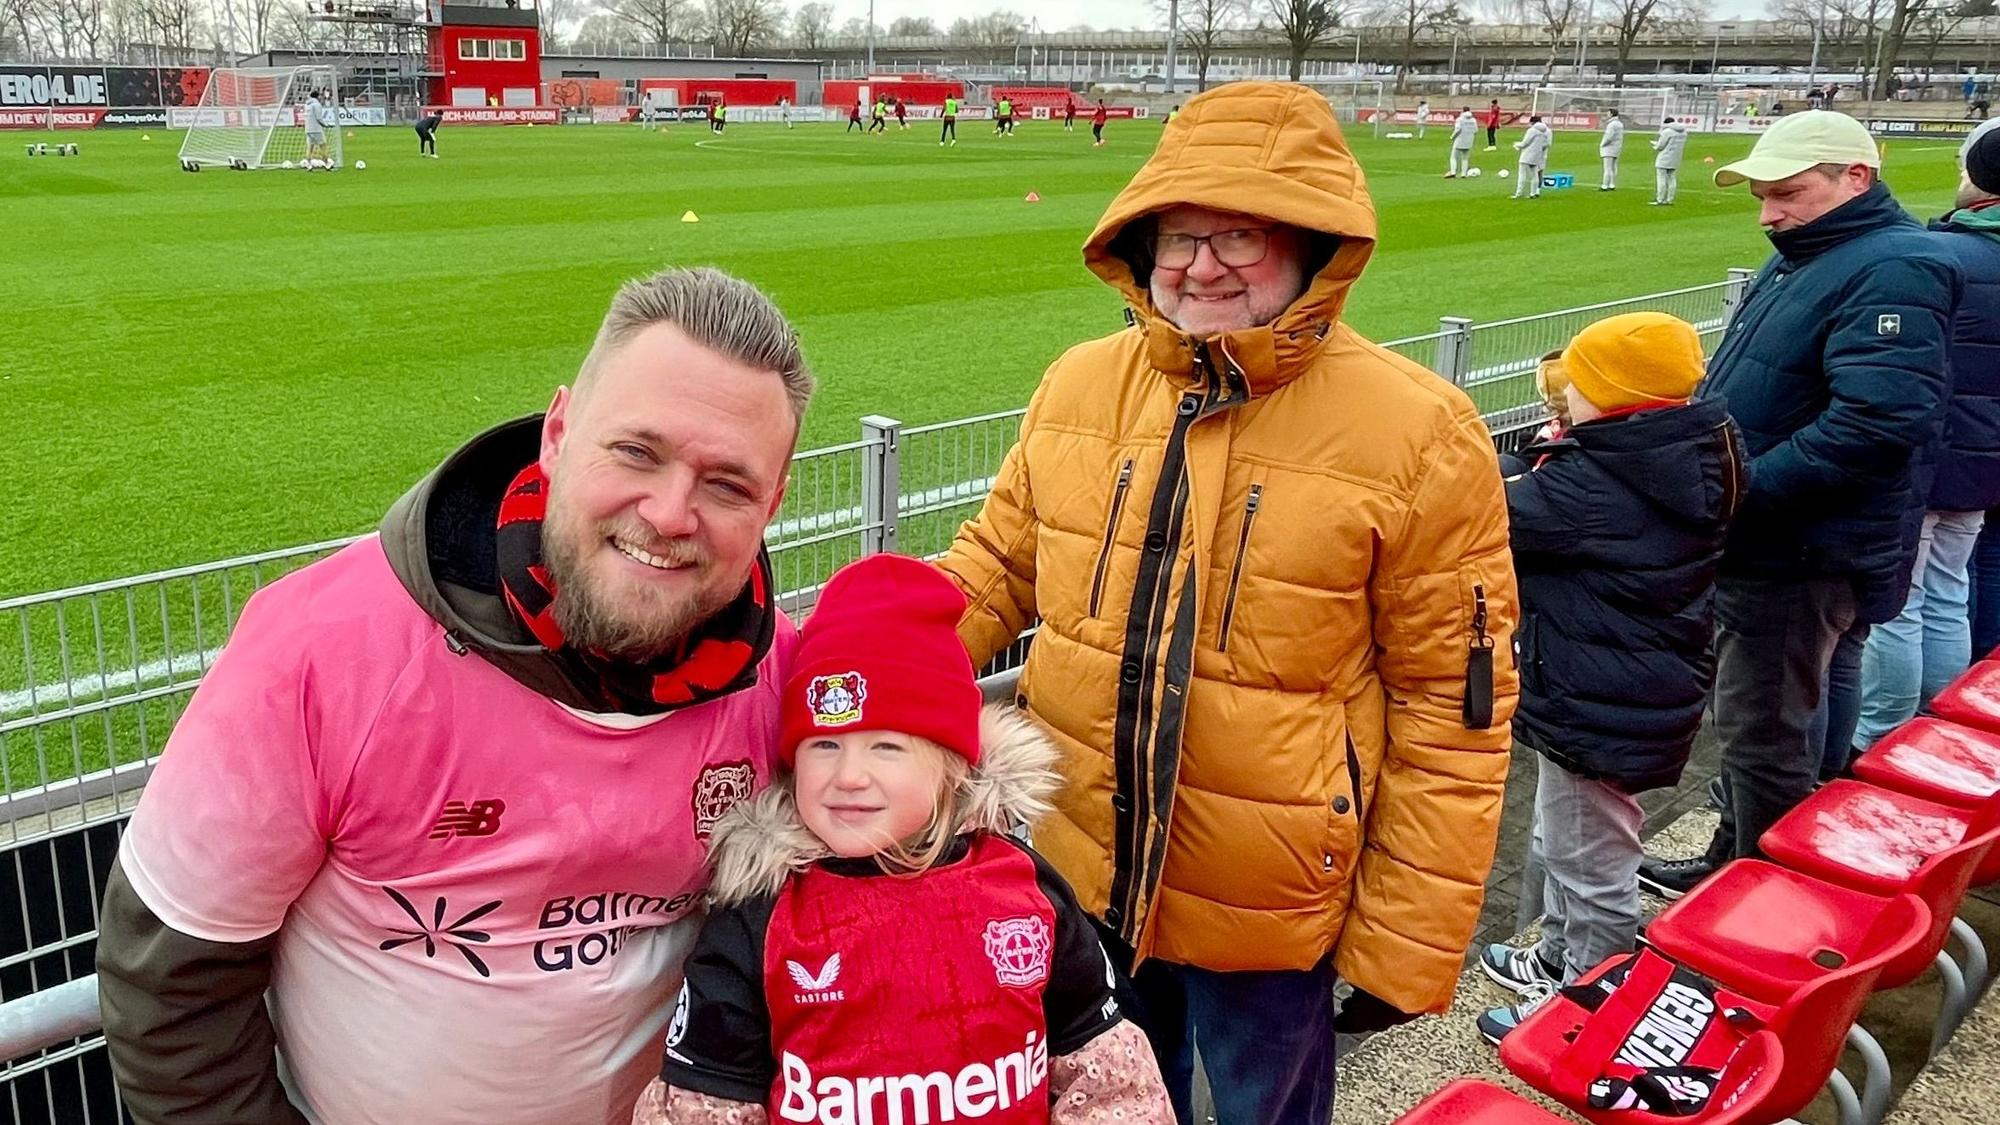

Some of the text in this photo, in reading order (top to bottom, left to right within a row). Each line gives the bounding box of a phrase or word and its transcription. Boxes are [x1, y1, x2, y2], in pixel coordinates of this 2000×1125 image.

[15, 113, 34, 124] DIE
[35, 113, 96, 124] WRKSELF
[794, 990, 845, 1004] CASTORE
[779, 1030, 1048, 1125] Barmenia
